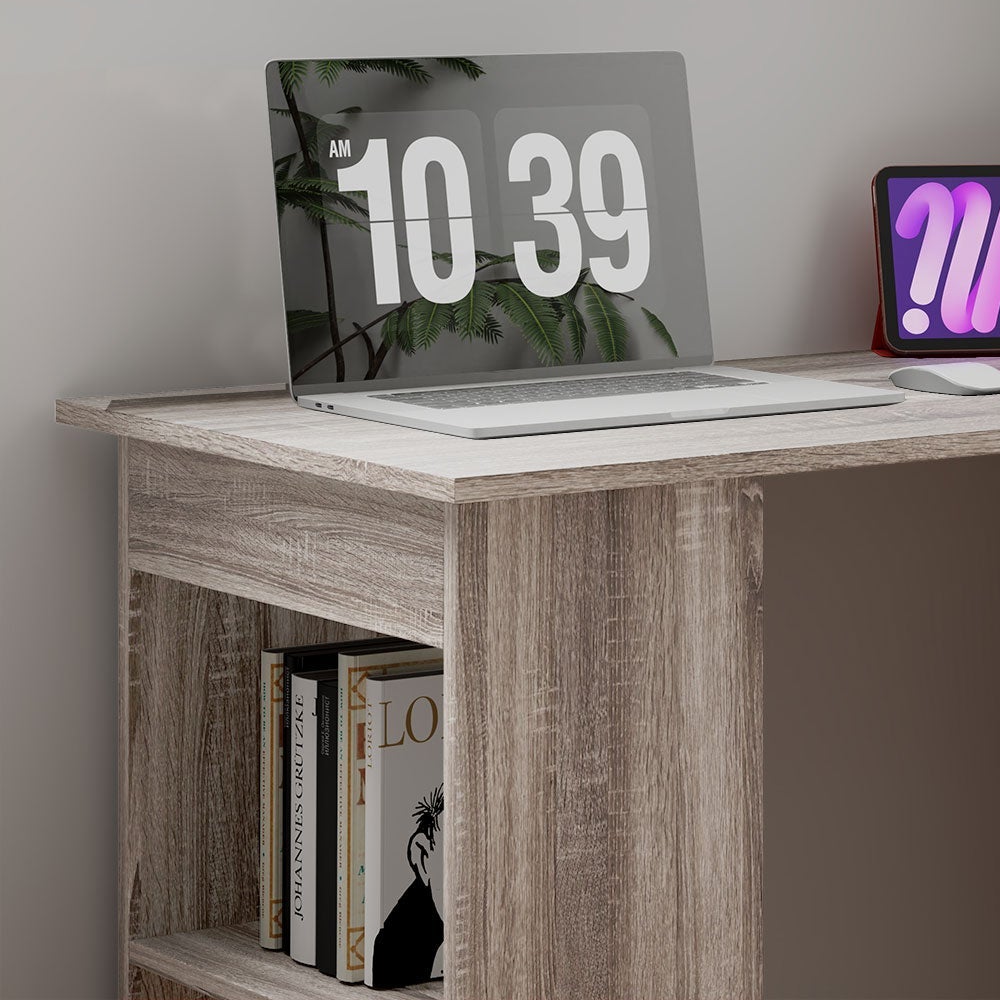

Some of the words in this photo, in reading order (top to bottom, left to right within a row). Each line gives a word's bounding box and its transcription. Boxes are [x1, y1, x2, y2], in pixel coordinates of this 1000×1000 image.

[329, 139, 351, 158] AM
[337, 135, 477, 305] 10
[508, 130, 651, 298] 39
[379, 694, 443, 749] LO
[293, 803, 304, 921] JOHANNES
